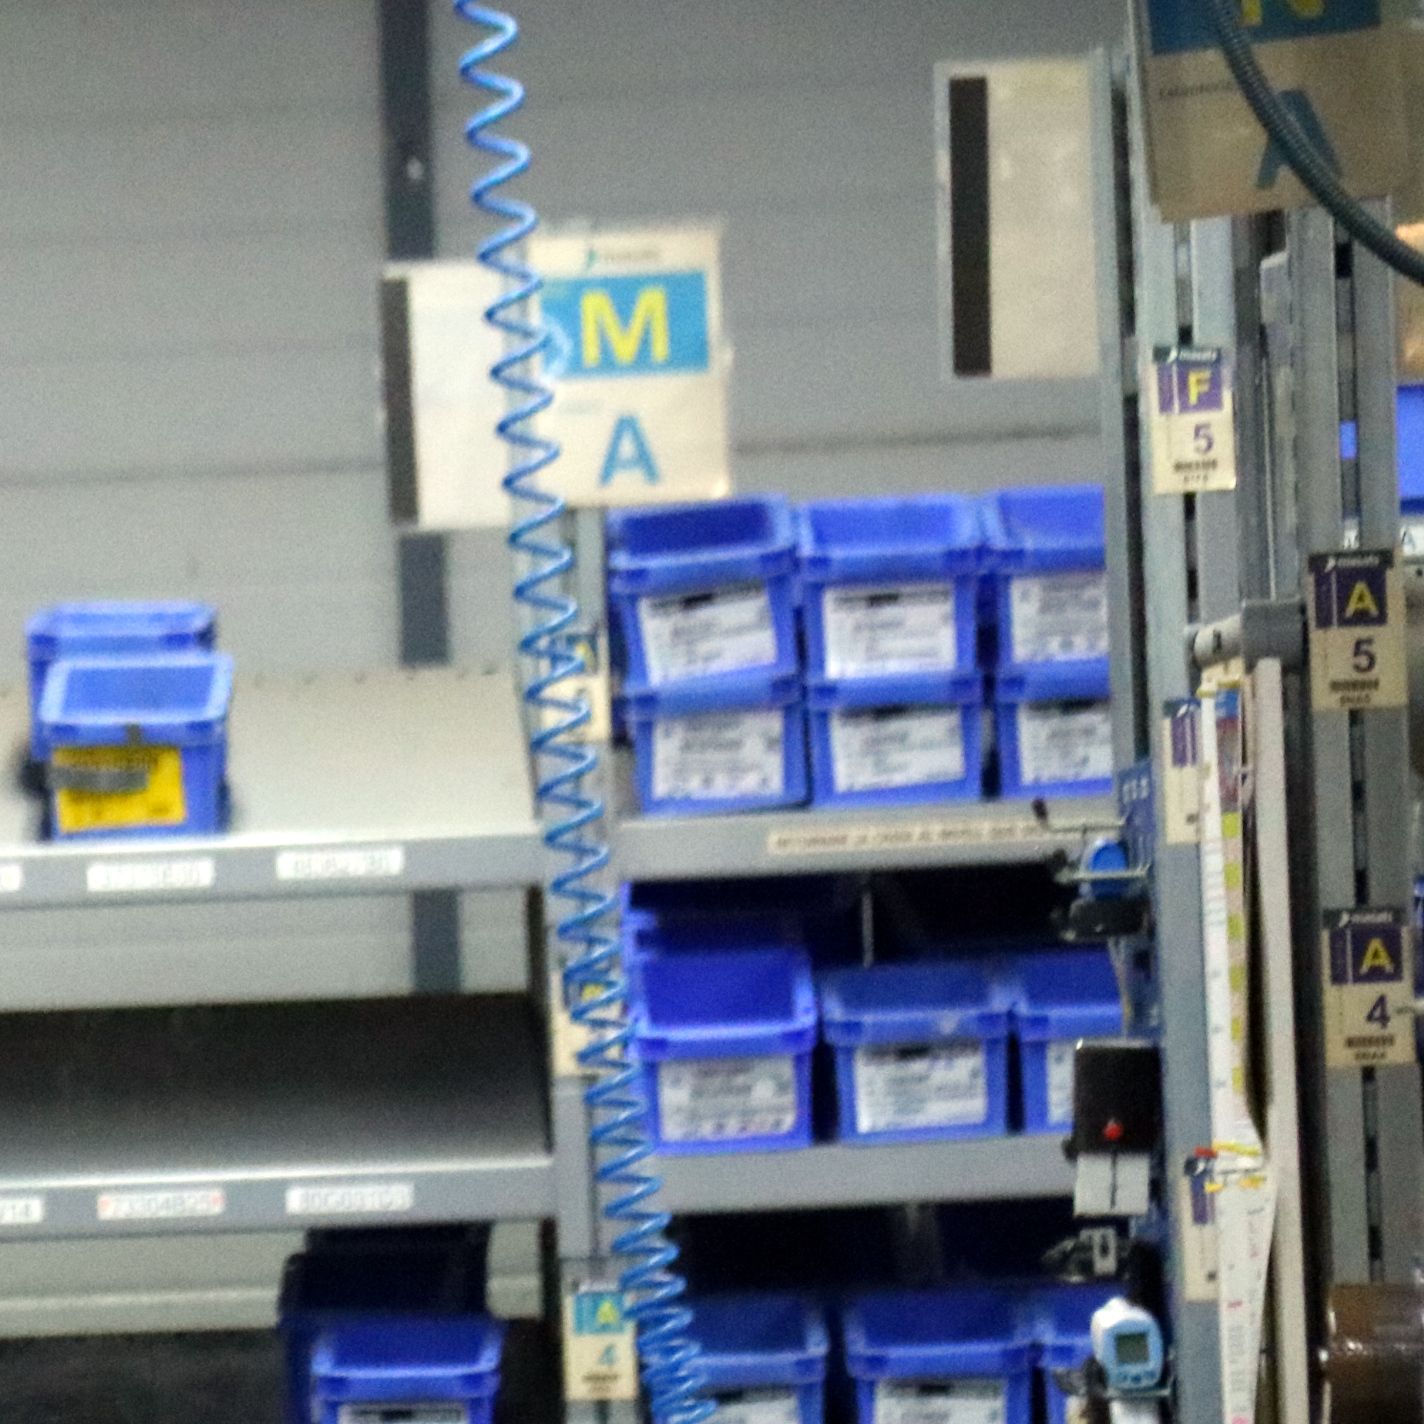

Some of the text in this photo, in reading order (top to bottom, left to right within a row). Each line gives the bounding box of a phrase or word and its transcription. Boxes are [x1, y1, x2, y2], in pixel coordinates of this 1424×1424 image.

[580, 287, 669, 367] M
[1188, 370, 1212, 405] F
[600, 415, 660, 485] A
[1194, 423, 1214, 454] 5
[1345, 580, 1380, 618] A
[1353, 637, 1377, 674] 5
[1358, 936, 1395, 975] A
[1365, 993, 1391, 1029] 4
